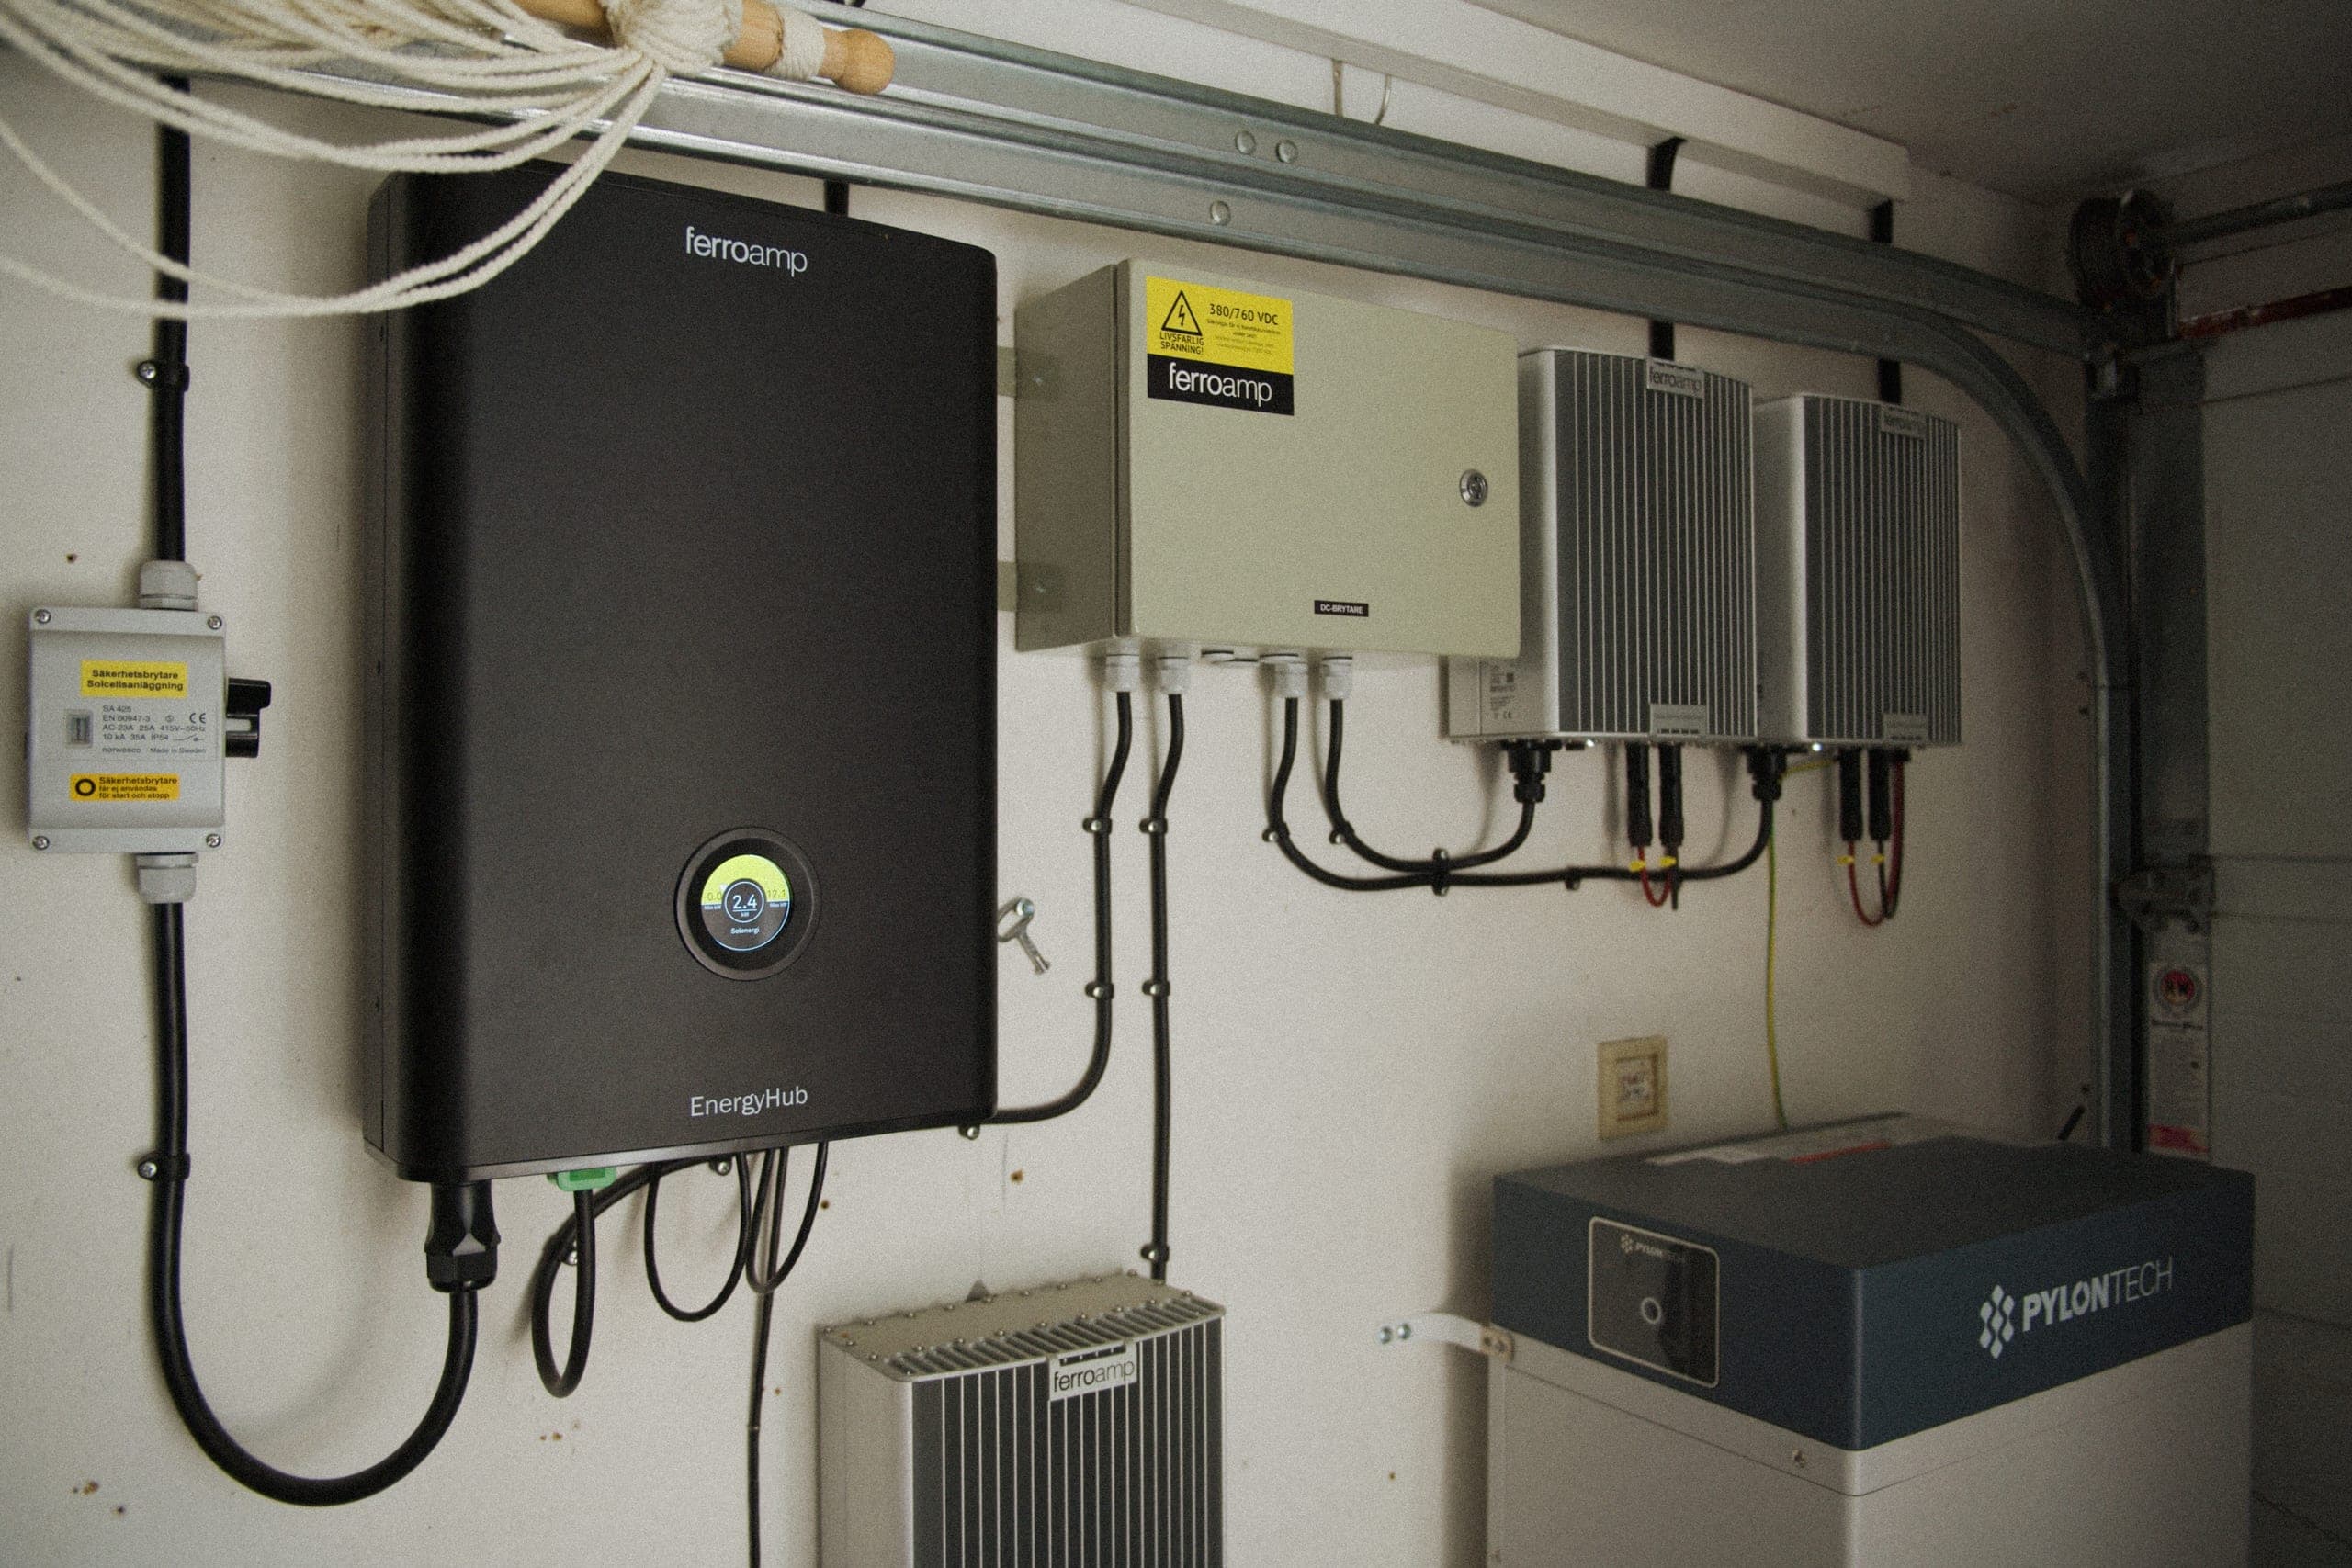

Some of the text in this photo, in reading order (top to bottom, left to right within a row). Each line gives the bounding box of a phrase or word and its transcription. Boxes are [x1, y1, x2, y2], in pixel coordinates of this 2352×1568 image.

[686, 226, 808, 277] ferroamp
[1209, 303, 1278, 325] 380/760 VDC
[1170, 362, 1272, 407] ferroamp
[1320, 604, 1363, 615] DC-BRYTARE
[87, 680, 184, 691] Solcellsanläggning
[92, 669, 178, 680] Säkerhetsbrytare
[99, 777, 177, 785] Säkerhetsbrytare
[732, 894, 758, 909] 2.4
[691, 1086, 808, 1117] EnergyHub
[2022, 1256, 2173, 1332] PYLONTECH
[1054, 1361, 1135, 1393] ferroamp
